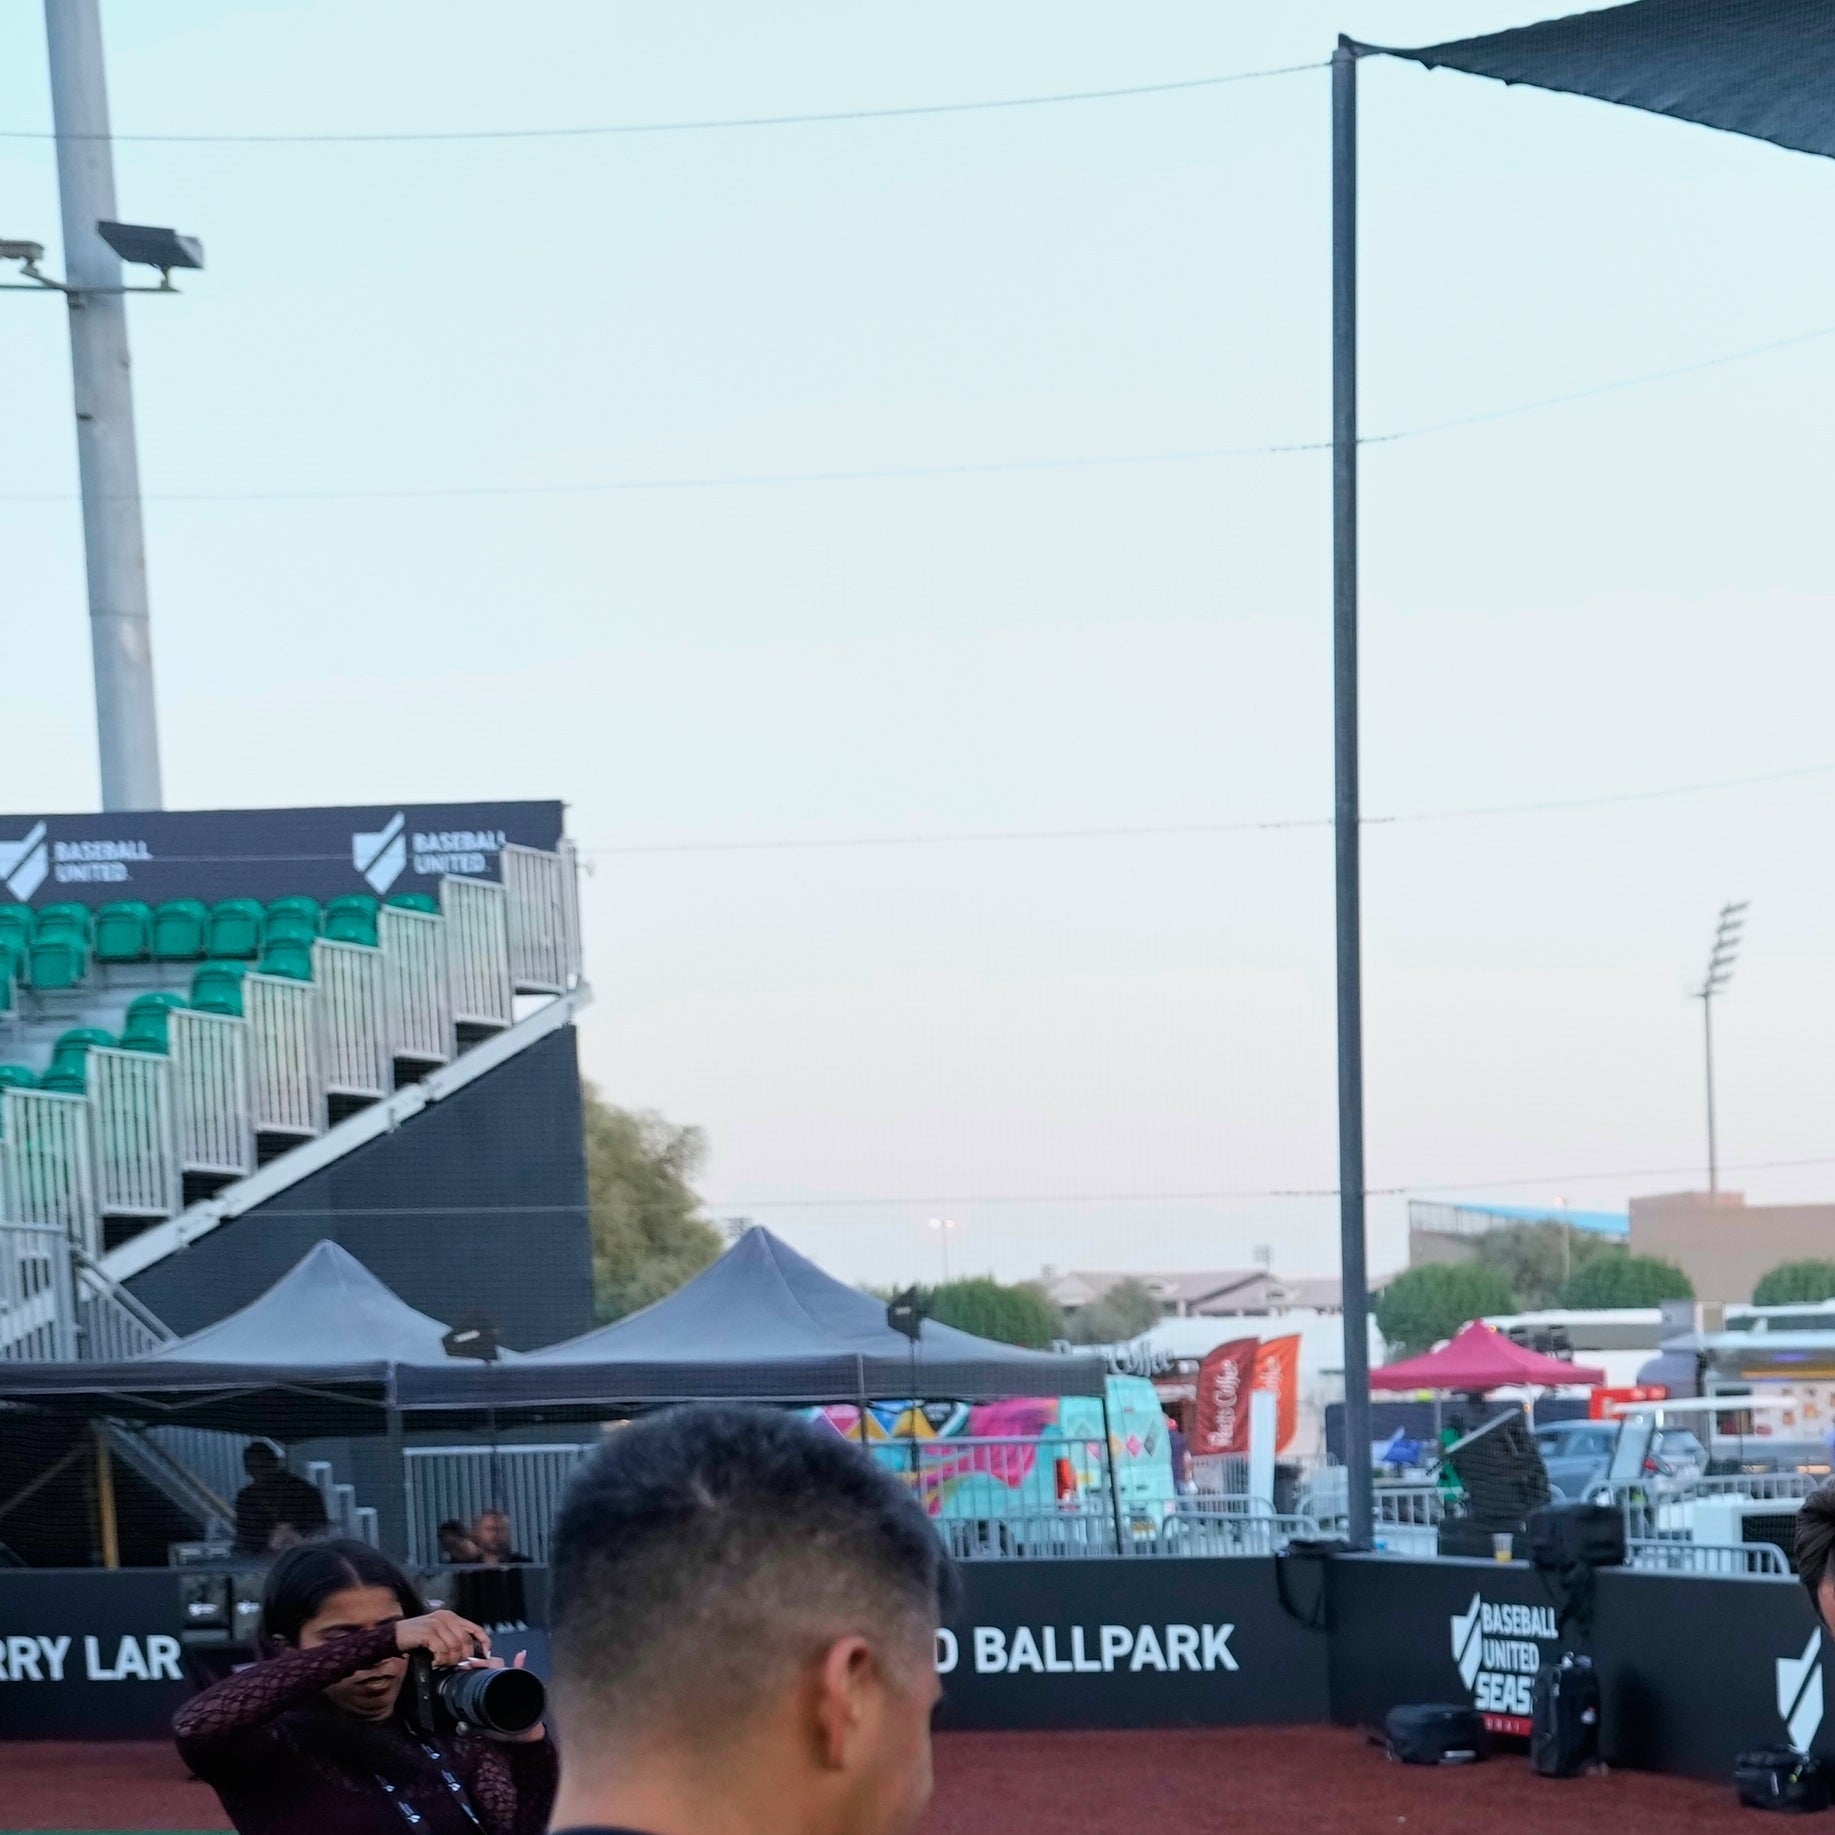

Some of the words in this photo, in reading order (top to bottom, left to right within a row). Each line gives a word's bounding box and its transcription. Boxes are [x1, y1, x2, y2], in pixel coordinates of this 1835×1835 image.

[54, 839, 154, 862] BASEBALL
[1480, 1601, 1559, 1639] BASEBALL
[973, 1623, 1240, 1674] BALLPARK
[1483, 1637, 1540, 1674] UNITED
[1474, 1671, 1536, 1717] SEAS
